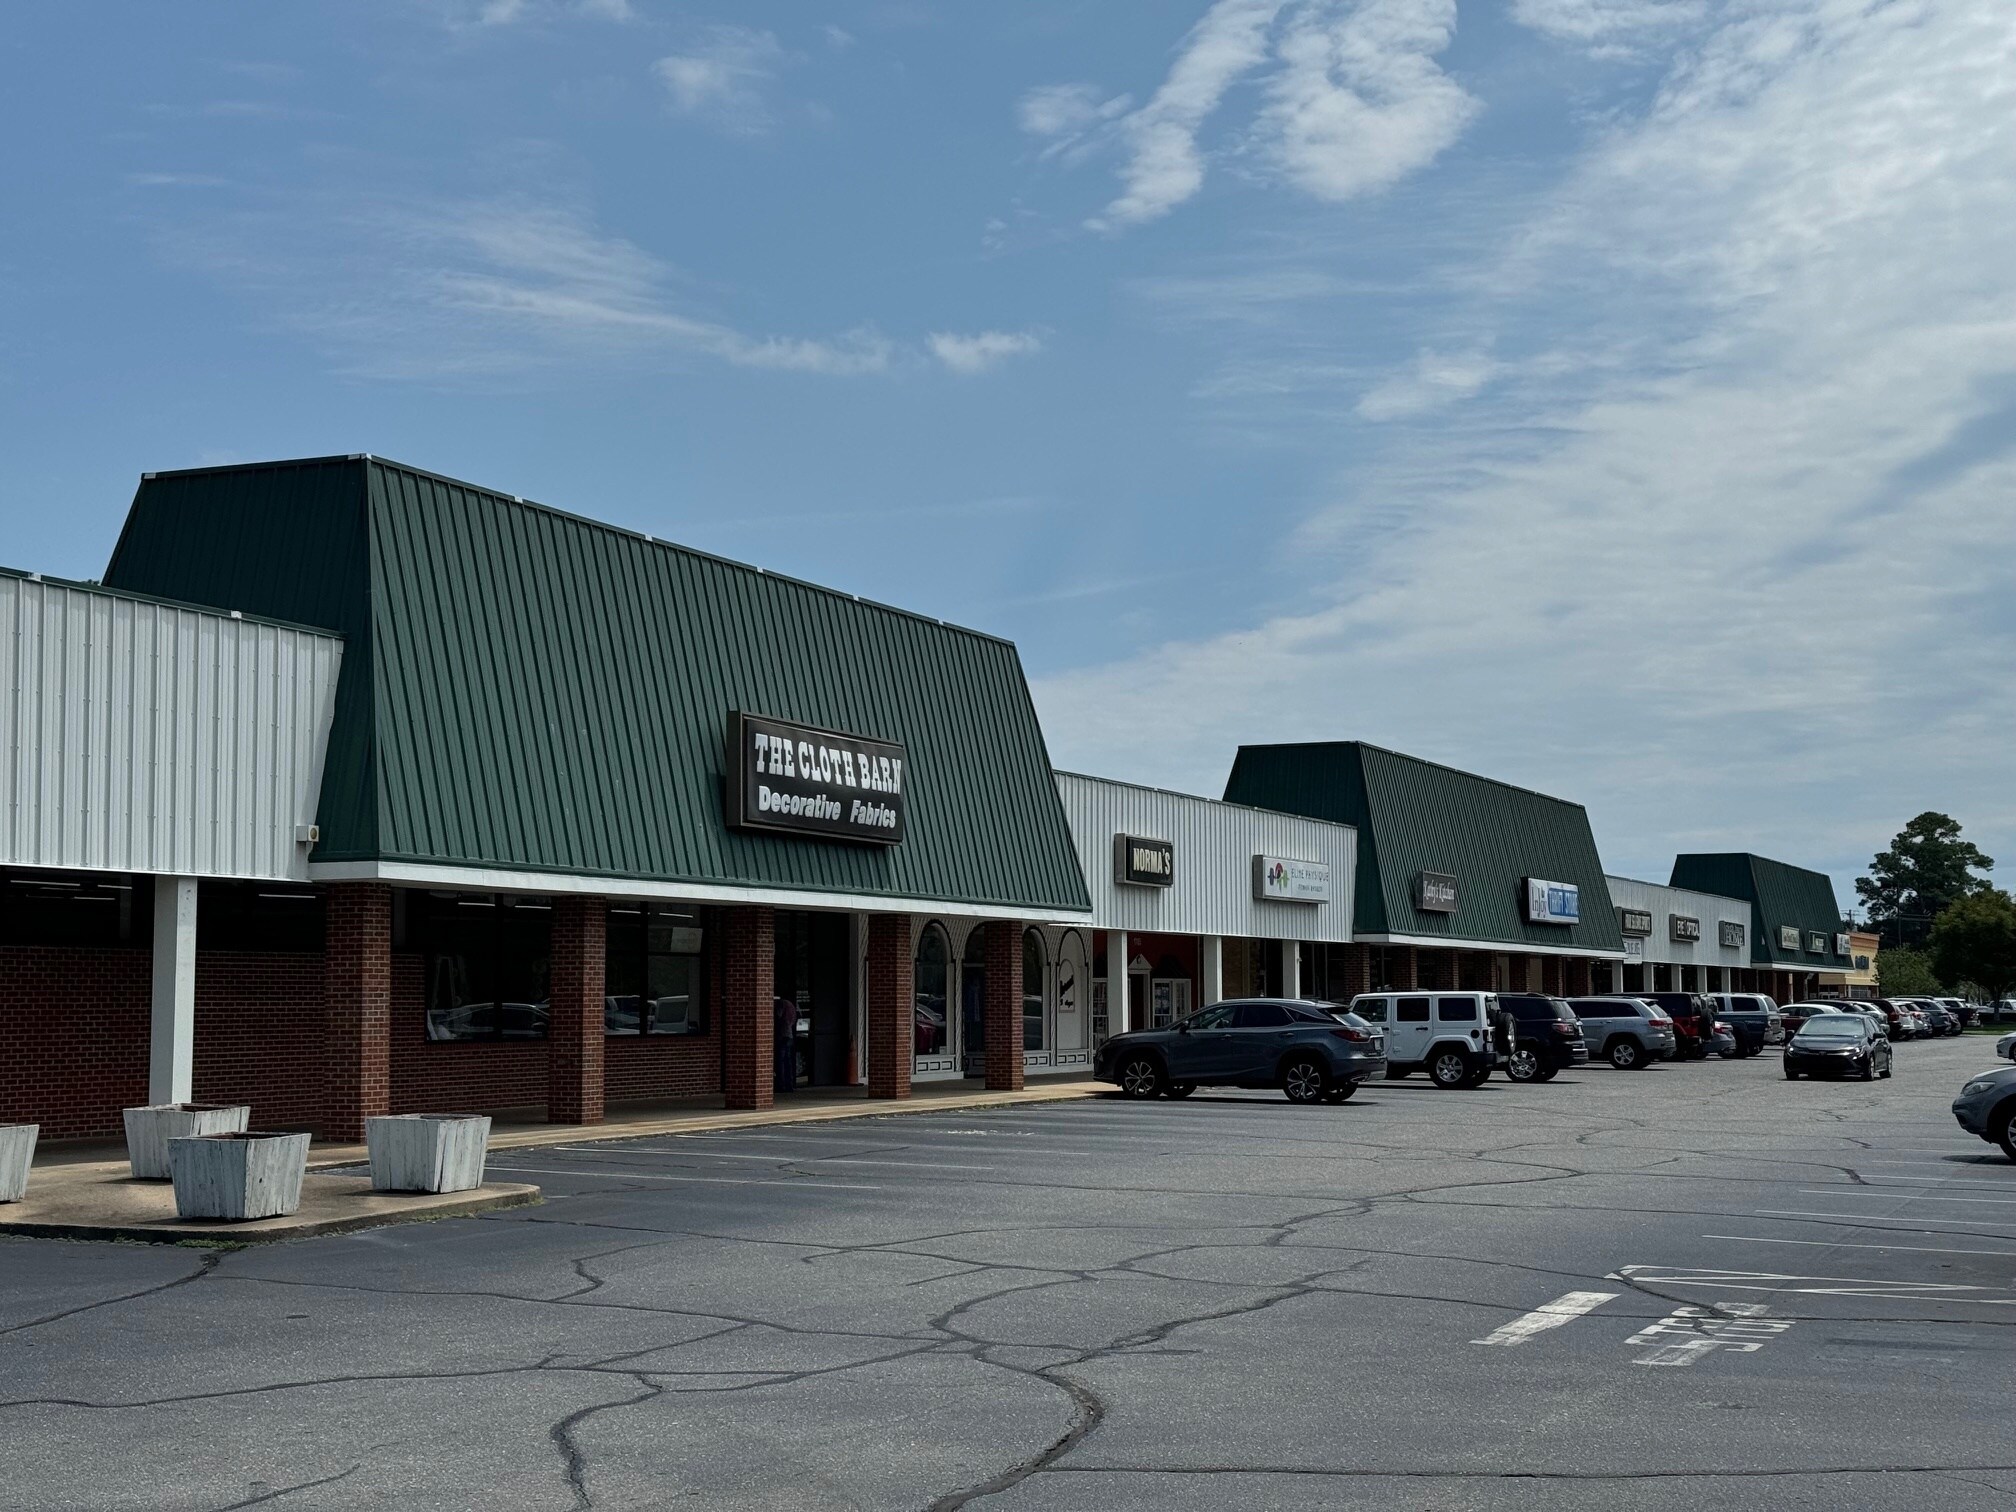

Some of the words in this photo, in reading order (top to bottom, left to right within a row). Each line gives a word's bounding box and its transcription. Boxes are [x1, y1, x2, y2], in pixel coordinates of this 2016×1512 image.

[755, 733, 795, 778] THE
[798, 741, 857, 787] CLOTH
[857, 753, 902, 794] BARN
[758, 785, 842, 821] Decorative
[850, 800, 896, 828] Fabrics
[1133, 847, 1171, 875] NORMA'S
